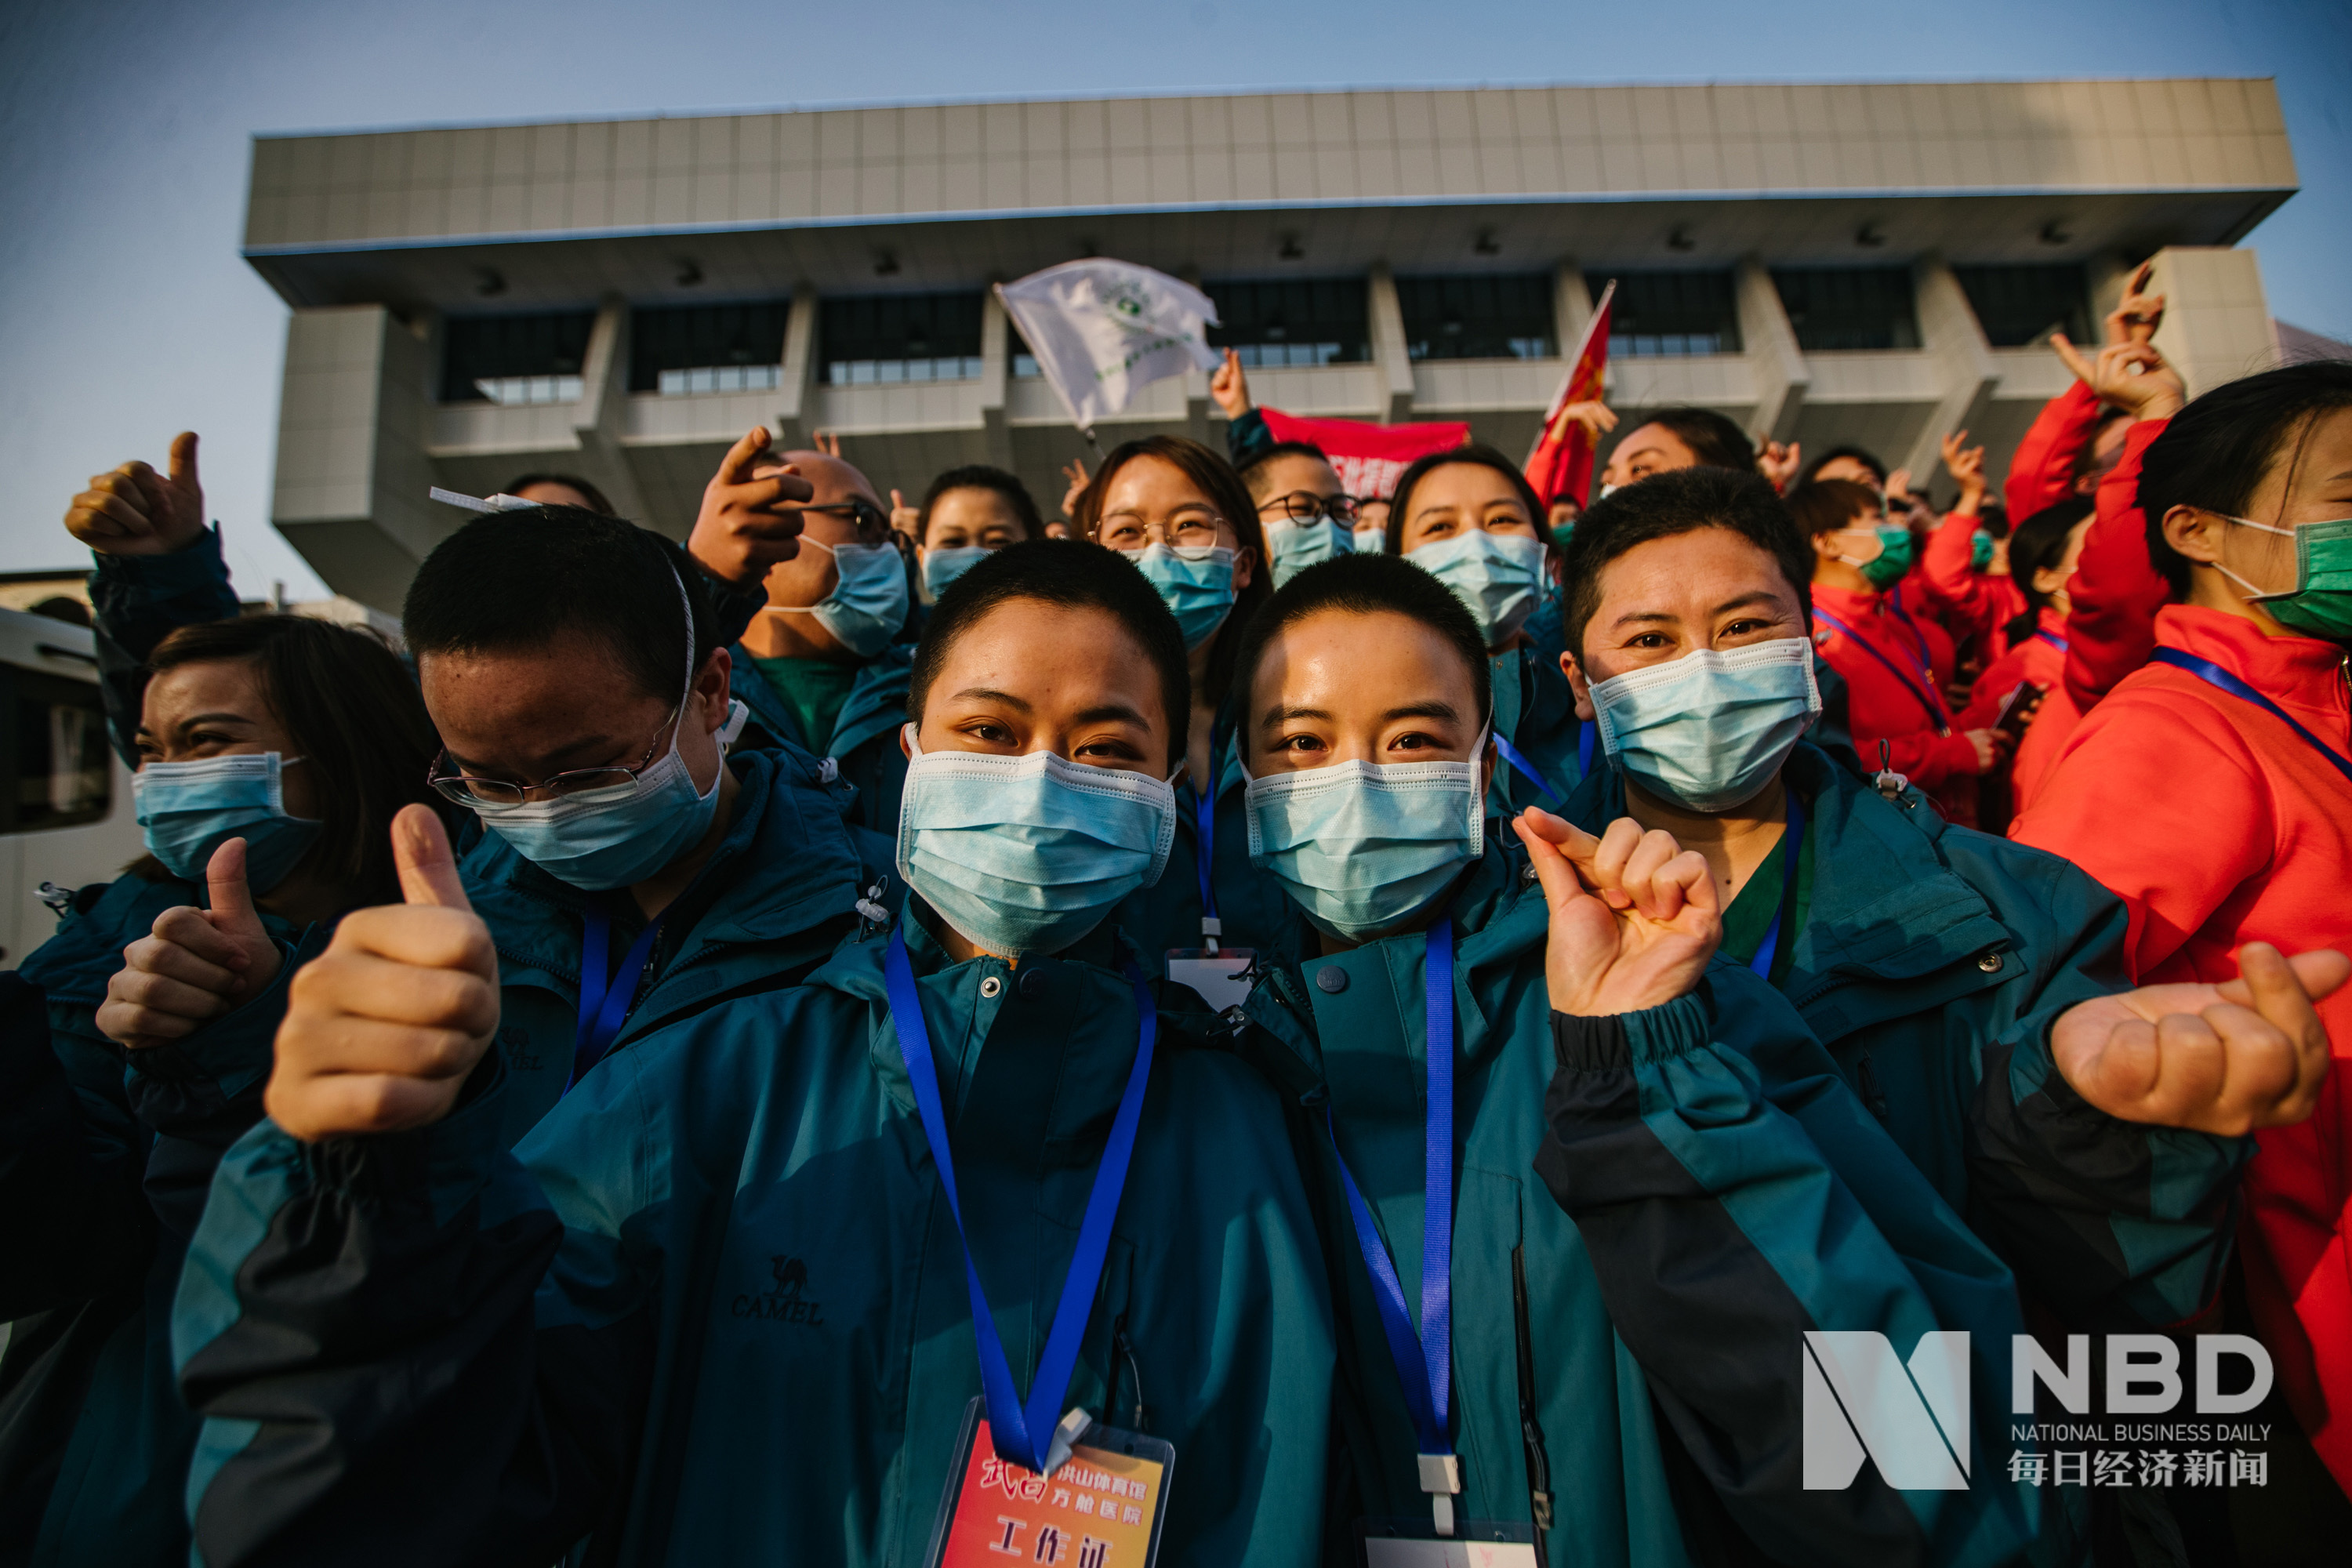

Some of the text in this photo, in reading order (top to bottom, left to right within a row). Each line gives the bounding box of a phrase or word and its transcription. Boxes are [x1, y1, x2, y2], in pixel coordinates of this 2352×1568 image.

[731, 1294, 824, 1326] CAMEL
[1057, 1464, 1148, 1501] 洪山体育馆
[1051, 1487, 1142, 1526] 方舱医院
[989, 1515, 1114, 1568] 工作证
